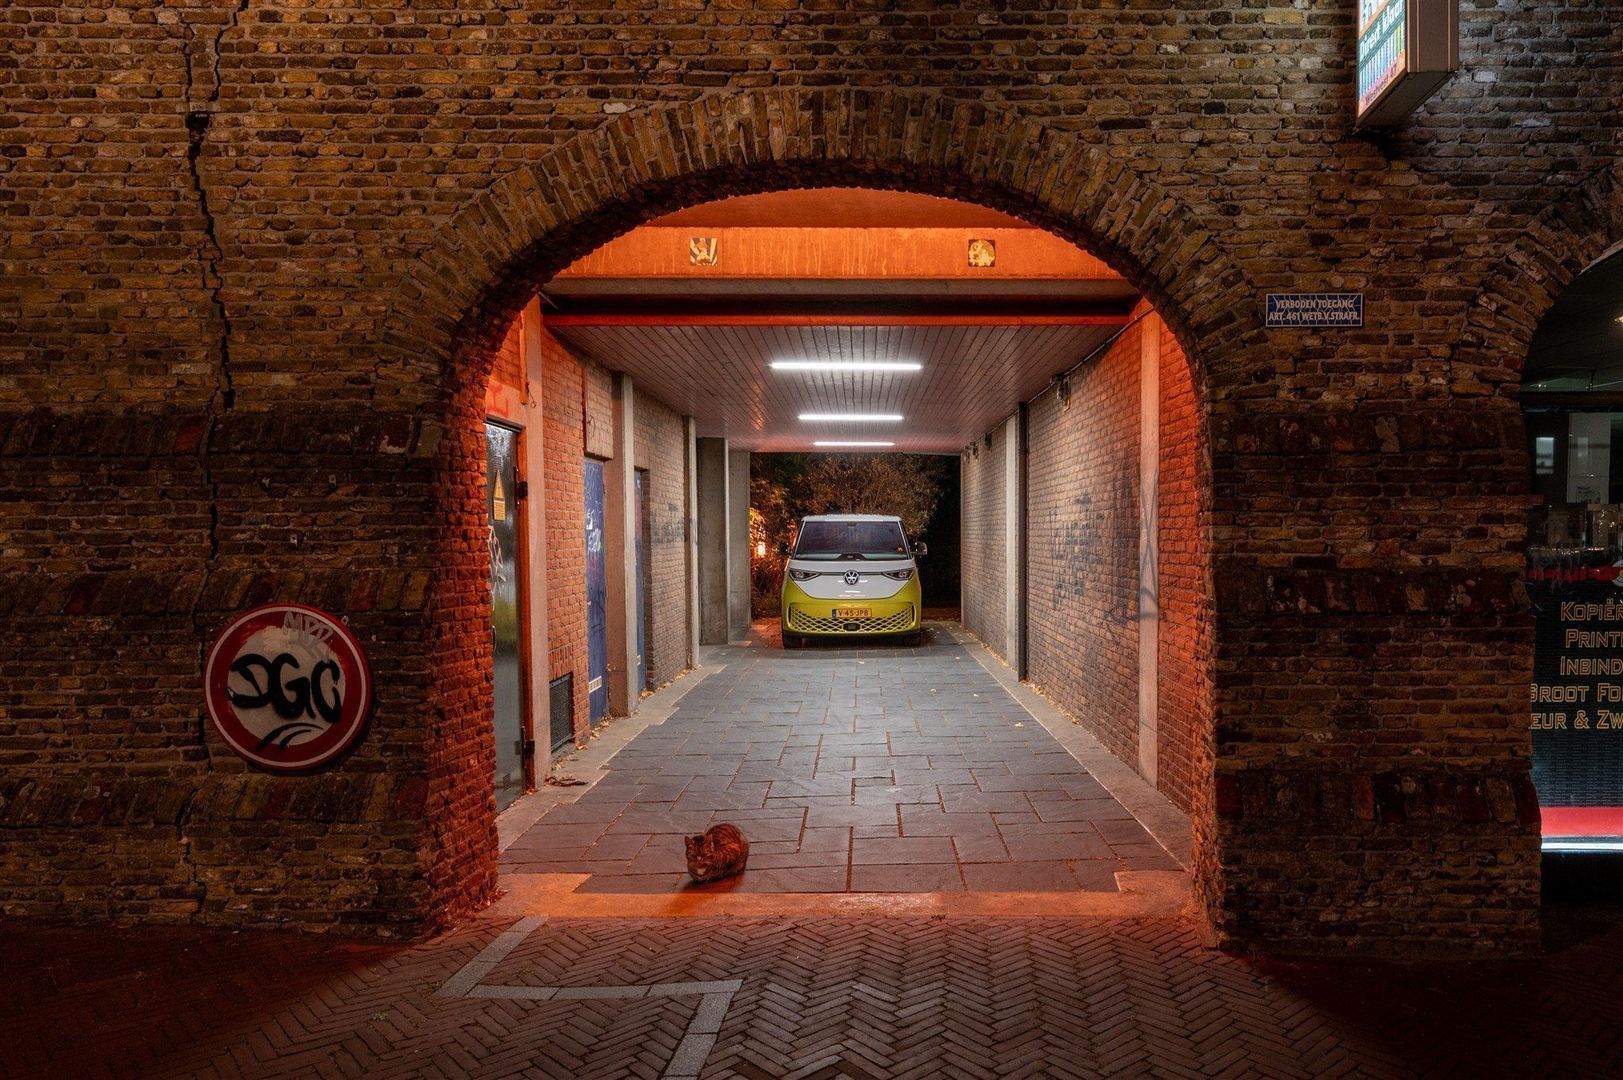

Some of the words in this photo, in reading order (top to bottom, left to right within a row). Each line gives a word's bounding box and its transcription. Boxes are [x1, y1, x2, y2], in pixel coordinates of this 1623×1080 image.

[1276, 299, 1316, 309] VERBODEN
[1318, 299, 1354, 309] TOEGANG
[1287, 311, 1300, 320] 461
[1574, 709, 1590, 730] &
